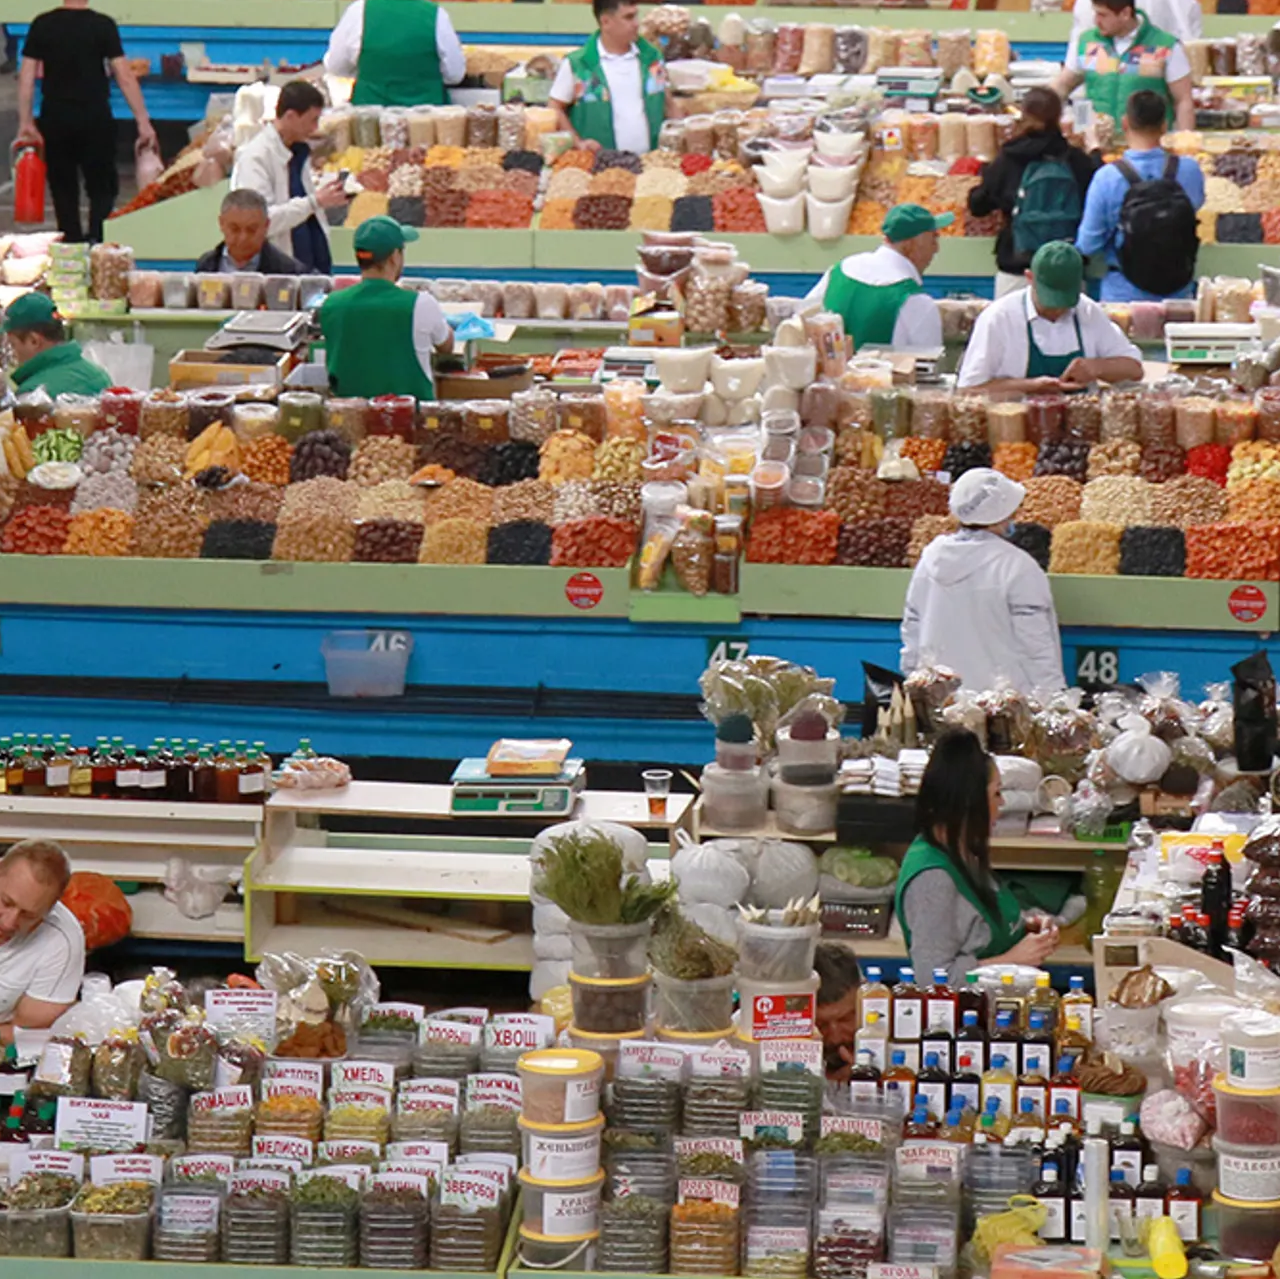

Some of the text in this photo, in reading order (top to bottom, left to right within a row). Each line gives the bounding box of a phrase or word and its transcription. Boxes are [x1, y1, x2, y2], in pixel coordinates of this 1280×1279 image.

[708, 641, 749, 664] 47
[1078, 650, 1118, 685] 48
[343, 1067, 385, 1083] ХМЕЛЬ
[194, 1091, 249, 1111] РОМАШКА
[91, 1111, 111, 1120] ЧАЙ
[256, 1141, 310, 1157] МЕЛИССА
[445, 1179, 495, 1199] ЗВЕРОБОЙ
